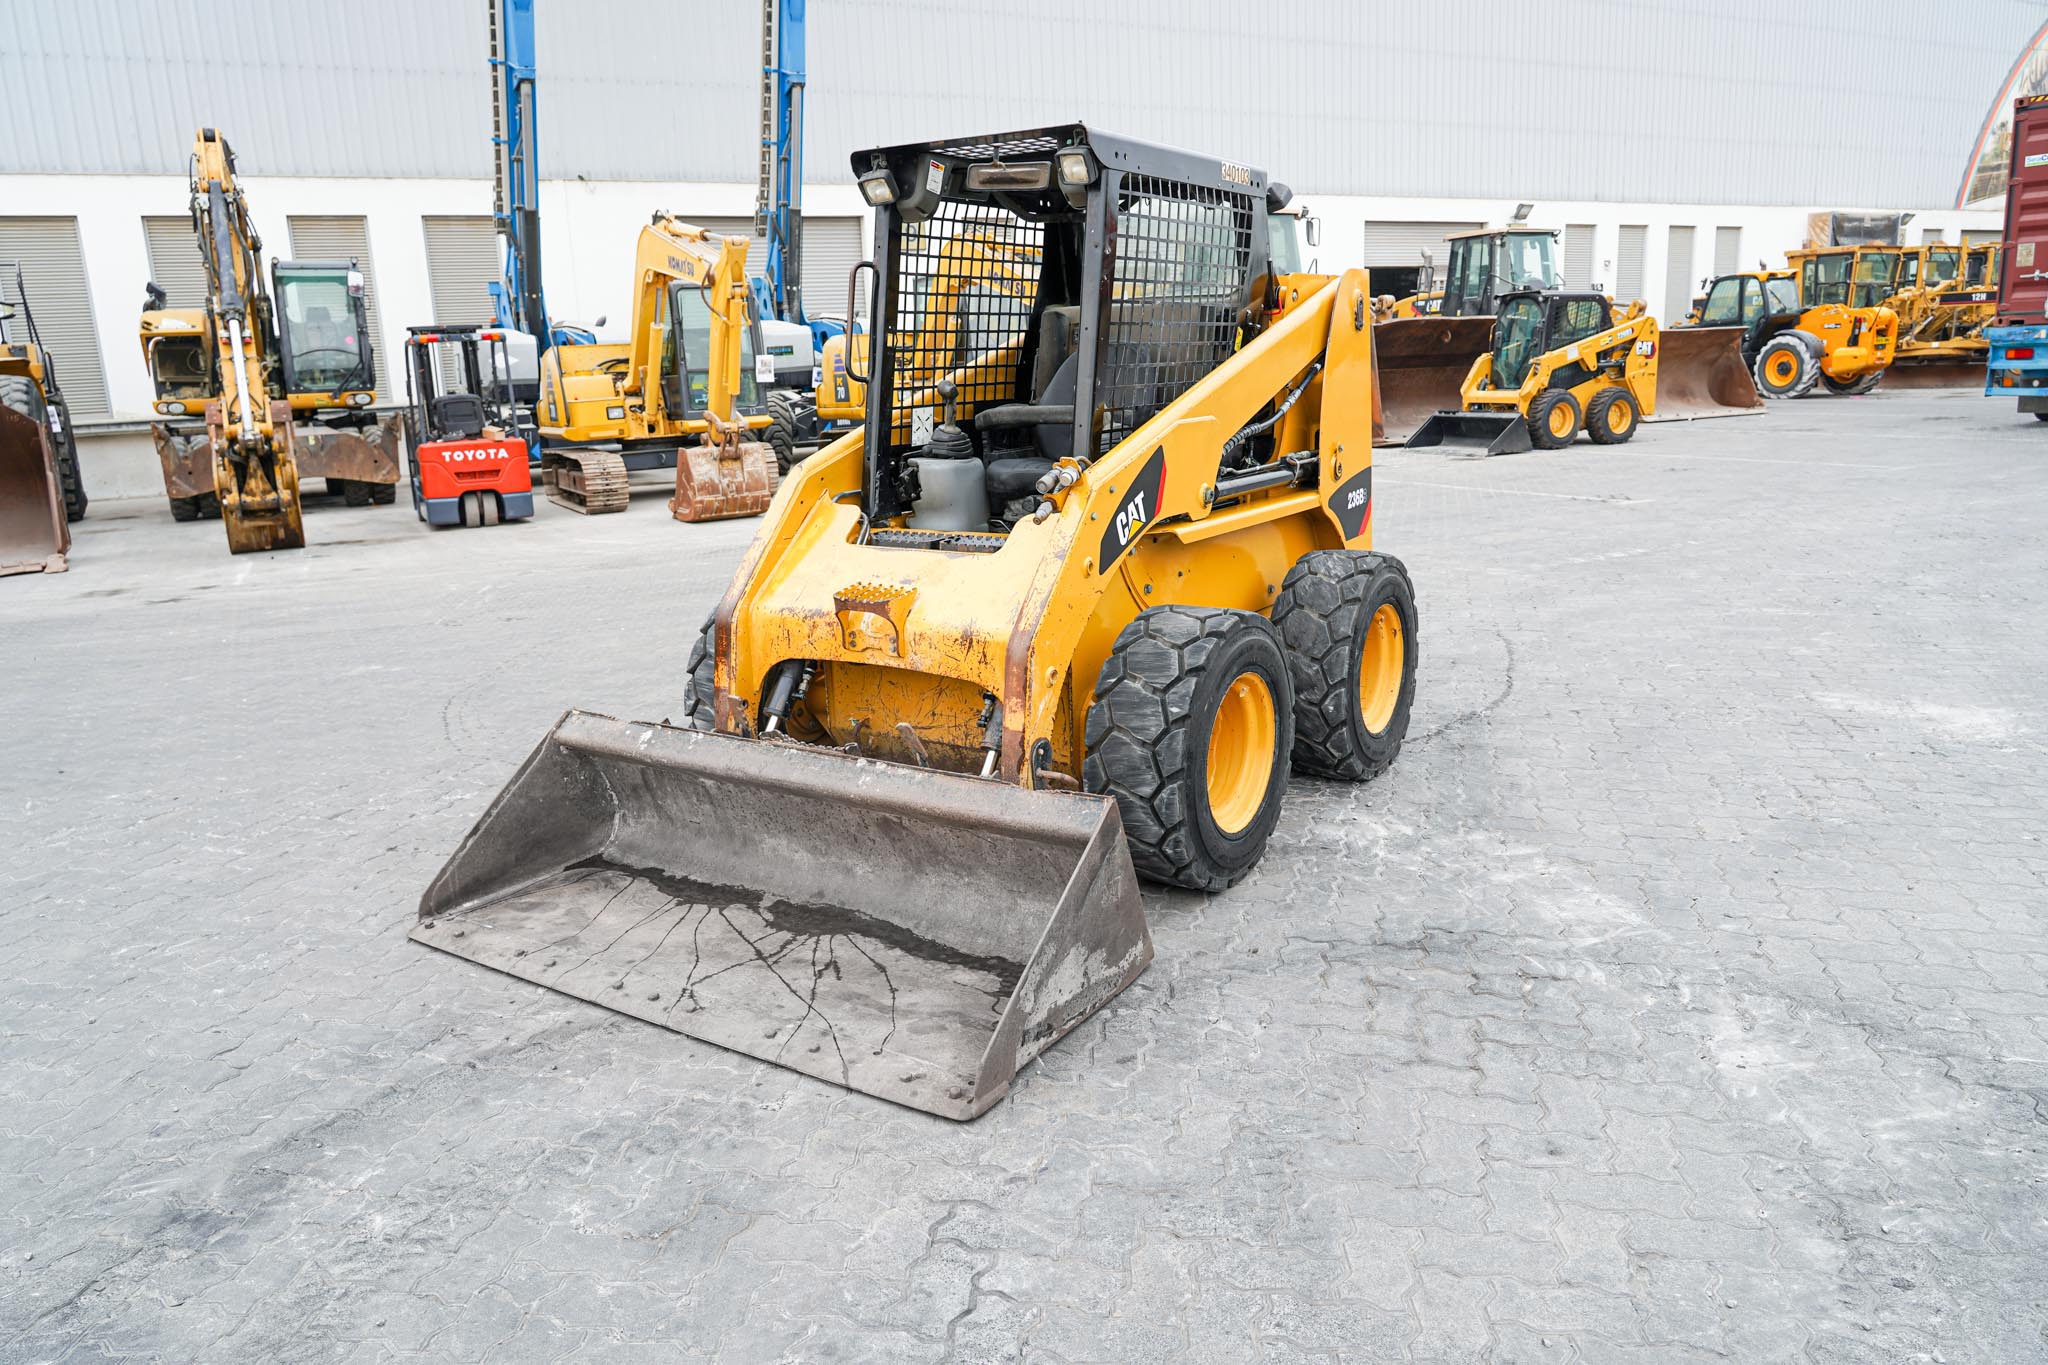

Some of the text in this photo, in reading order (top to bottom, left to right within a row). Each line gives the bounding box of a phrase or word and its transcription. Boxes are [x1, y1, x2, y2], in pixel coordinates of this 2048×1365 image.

[1222, 163, 1250, 184] 340103
[668, 255, 694, 277] KOMATSU
[1971, 292, 1987, 301] 12H
[1426, 299, 1442, 312] CAT
[1635, 341, 1653, 355] CAT
[836, 386, 846, 400] 70
[441, 448, 509, 462] TOYOTA
[1116, 490, 1147, 546] CAT
